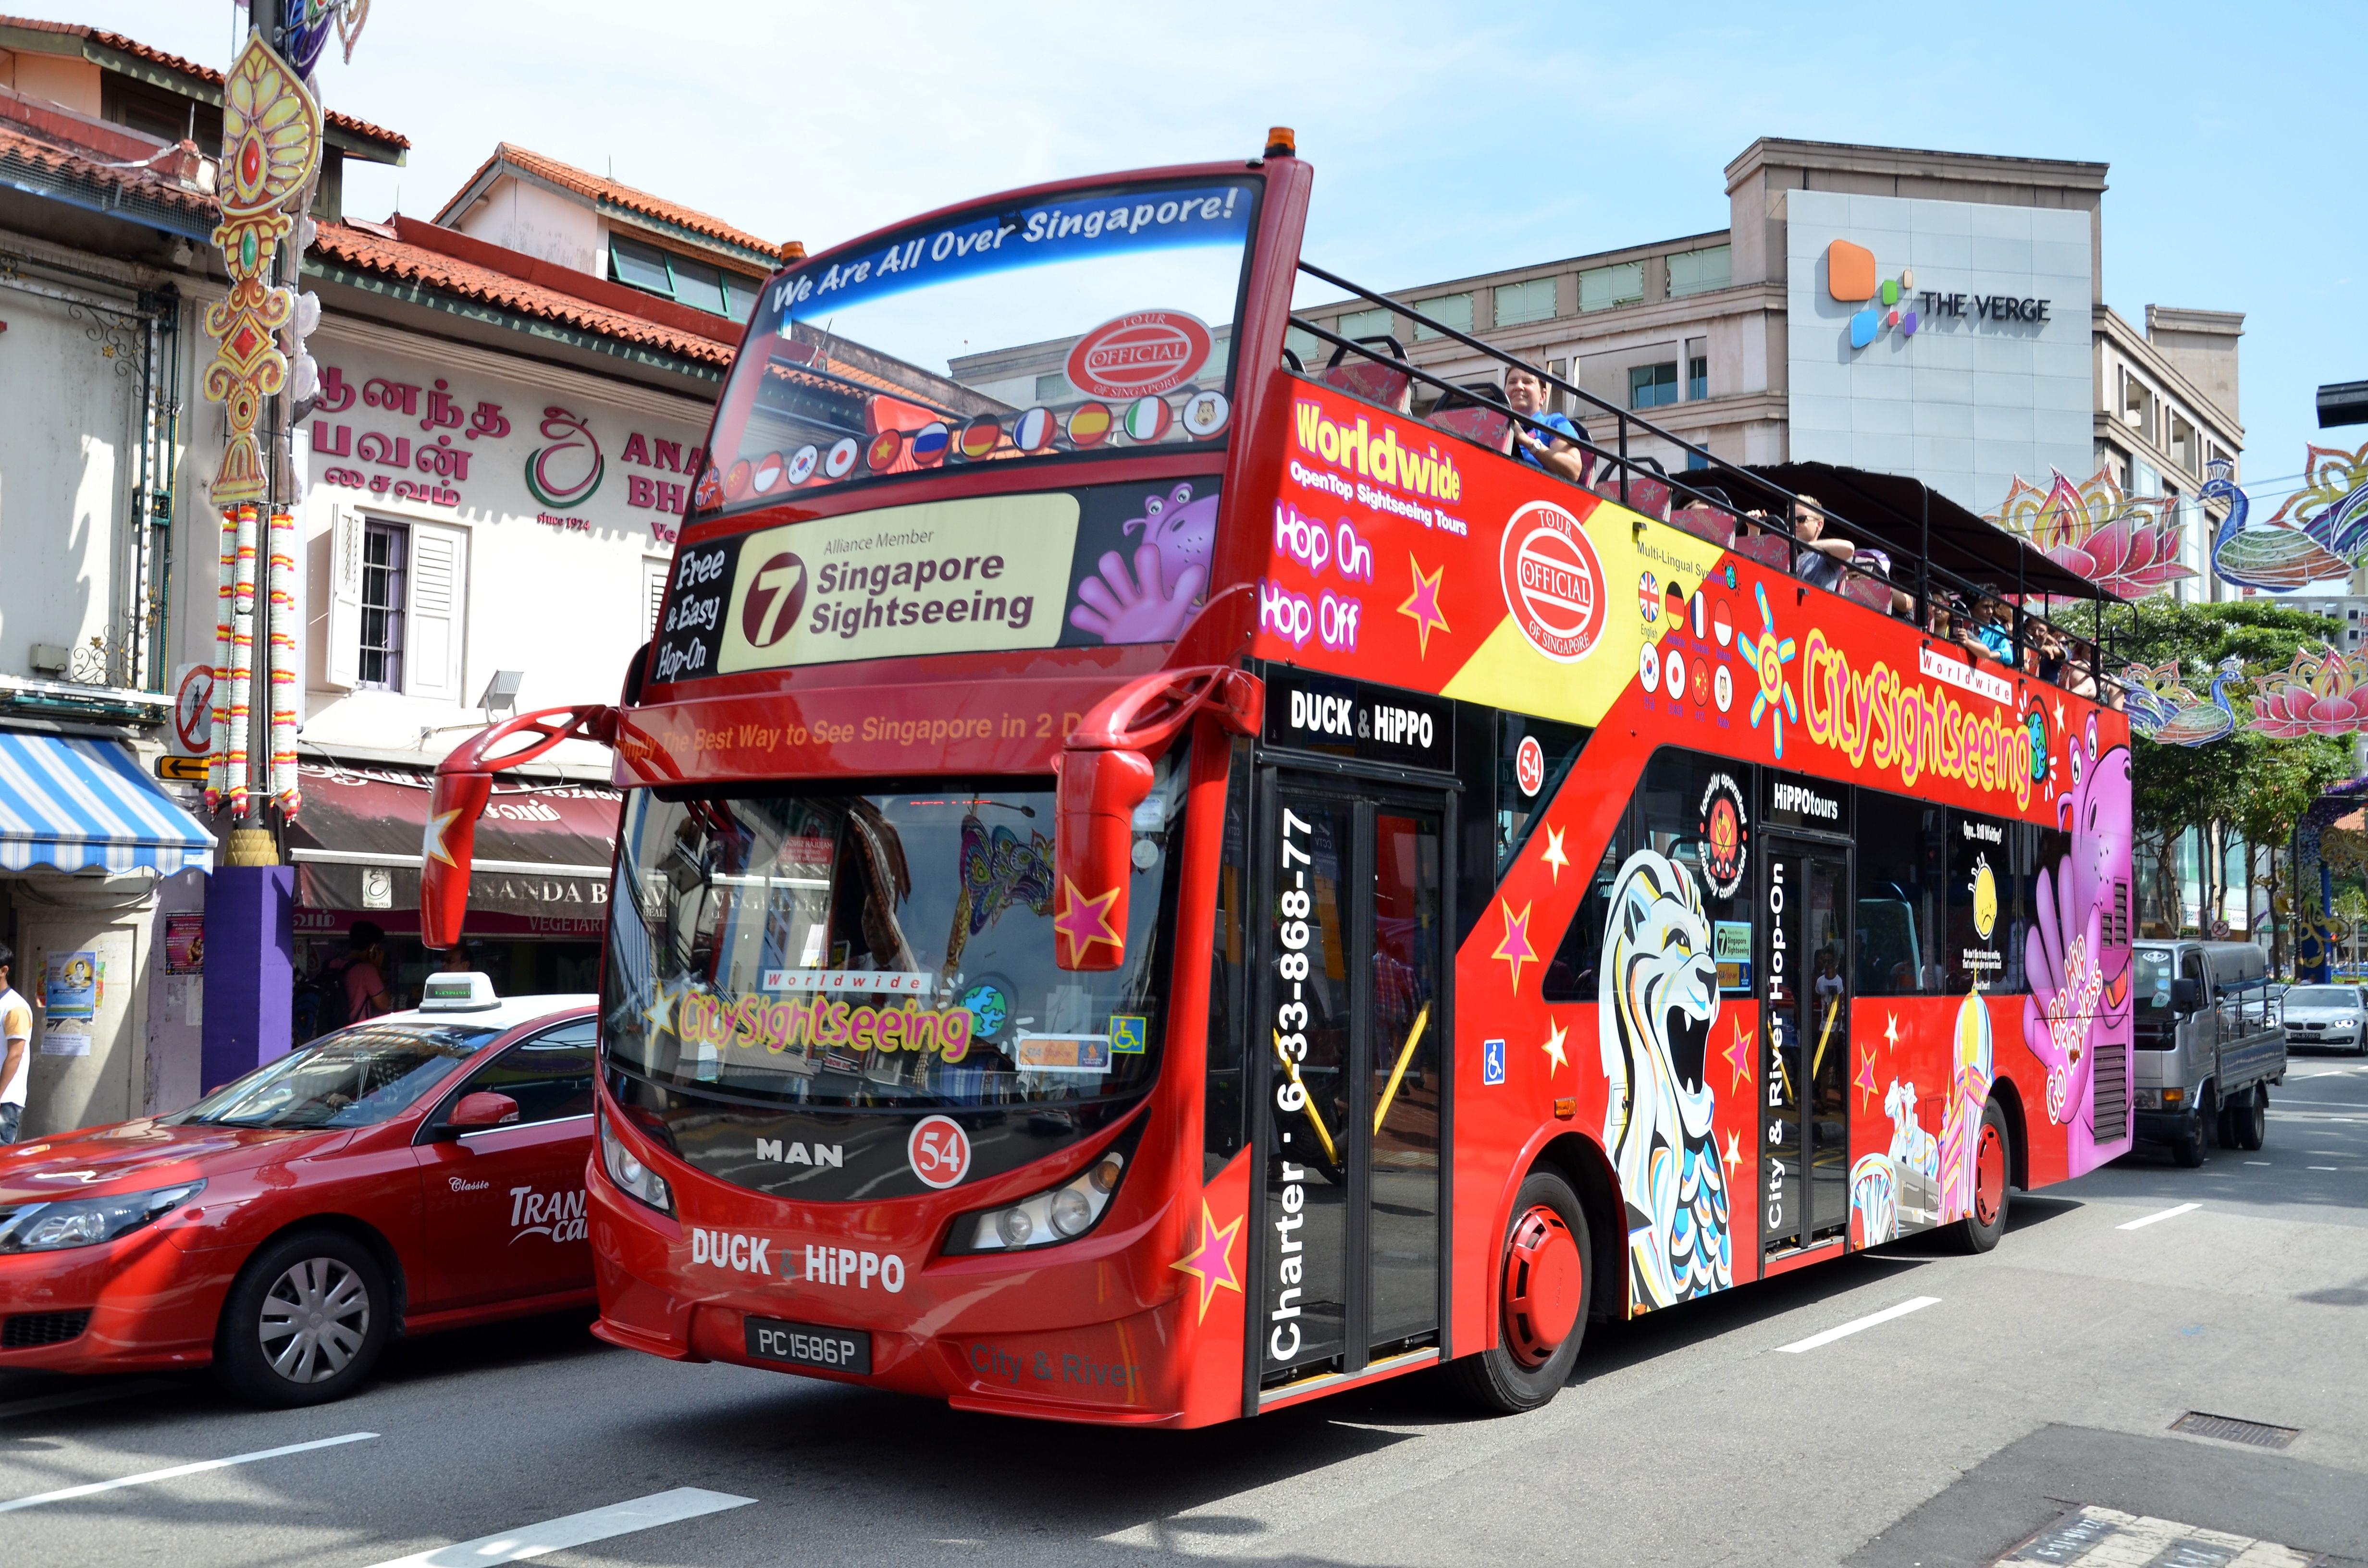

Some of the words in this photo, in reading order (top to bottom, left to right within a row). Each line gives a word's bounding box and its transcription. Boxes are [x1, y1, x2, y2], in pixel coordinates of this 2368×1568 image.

[772, 275, 811, 313] We
[817, 260, 872, 296] Are
[876, 237, 926, 278] All
[931, 224, 1016, 261] Over
[1021, 187, 1239, 243] Singapore!
[1120, 312, 1167, 329] TOUR
[1920, 292, 1967, 317] THE
[1975, 295, 2051, 322] VERGE
[1089, 342, 1185, 366] OFFICIAL
[1093, 383, 1110, 397] OF
[1110, 375, 1181, 398] SINGAPORE
[621, 432, 703, 475] ANA
[1296, 401, 1460, 502] Worldwide
[628, 475, 686, 514] BH
[1357, 484, 1432, 528] Sightseeing
[1435, 506, 1467, 536] Tours
[537, 512, 564, 527] since
[566, 516, 590, 532] 1924
[824, 537, 873, 556] Alliance
[875, 528, 934, 549] Member
[1276, 504, 1329, 570] Hop
[1337, 523, 1371, 577] On
[1537, 509, 1573, 539] TOUR
[675, 549, 726, 591] Free
[816, 552, 1005, 596] Singapore
[1522, 560, 1590, 605] OFFICIAL
[1637, 540, 1693, 574] Multi-Lingual
[1695, 563, 1726, 586] System
[665, 606, 677, 633] &
[677, 593, 721, 631] Easy
[755, 564, 802, 647] 7
[809, 589, 1034, 639] Sightseeing
[1259, 583, 1312, 644] Hop
[1320, 594, 1358, 647] Off
[1529, 619, 1542, 637] OF
[1542, 632, 1591, 654] SINGAPORE
[1641, 624, 1658, 640] English
[655, 636, 707, 684] Hop-On
[1923, 650, 2010, 701] Worldwide
[661, 731, 690, 754] The
[693, 725, 734, 751] Best
[739, 723, 781, 753] Way
[786, 720, 808, 746] to
[812, 718, 855, 745] See
[861, 714, 992, 746] Singapore
[1000, 711, 1027, 738] in
[1035, 711, 1052, 738] 2
[1291, 689, 1353, 736] DUCK
[1357, 709, 1371, 739] &
[1374, 704, 1433, 749] HiPPO
[1521, 749, 1540, 784] 54
[1700, 773, 1720, 817] locally
[1720, 773, 1747, 824] operated
[1774, 783, 1838, 820] HiPPOtours
[1698, 841, 1719, 897] globally
[1719, 845, 1747, 899] connected
[468, 880, 583, 903] NANDA
[529, 916, 606, 932] VEGETARI
[1727, 937, 1746, 946] Singapore
[1769, 863, 1787, 1000] Hop-On
[1277, 807, 1313, 1113] 6-33-868-77
[1727, 946, 1749, 956] Sightseeing
[767, 973, 921, 990] Worldwide
[1769, 1016, 1784, 1108] River
[919, 1132, 961, 1172] 54
[1768, 1118, 1783, 1145] &
[755, 1138, 844, 1168] MAN
[448, 1176, 490, 1192] Classic
[1768, 1157, 1786, 1229] City
[692, 1227, 771, 1275] DUCK
[778, 1249, 796, 1279] &
[805, 1244, 905, 1293] HiPPO
[1270, 1161, 1305, 1362] Charter
[758, 1329, 855, 1366] PC1586P
[971, 1343, 1024, 1385] City
[1033, 1350, 1053, 1381] &
[1062, 1353, 1141, 1388] River
